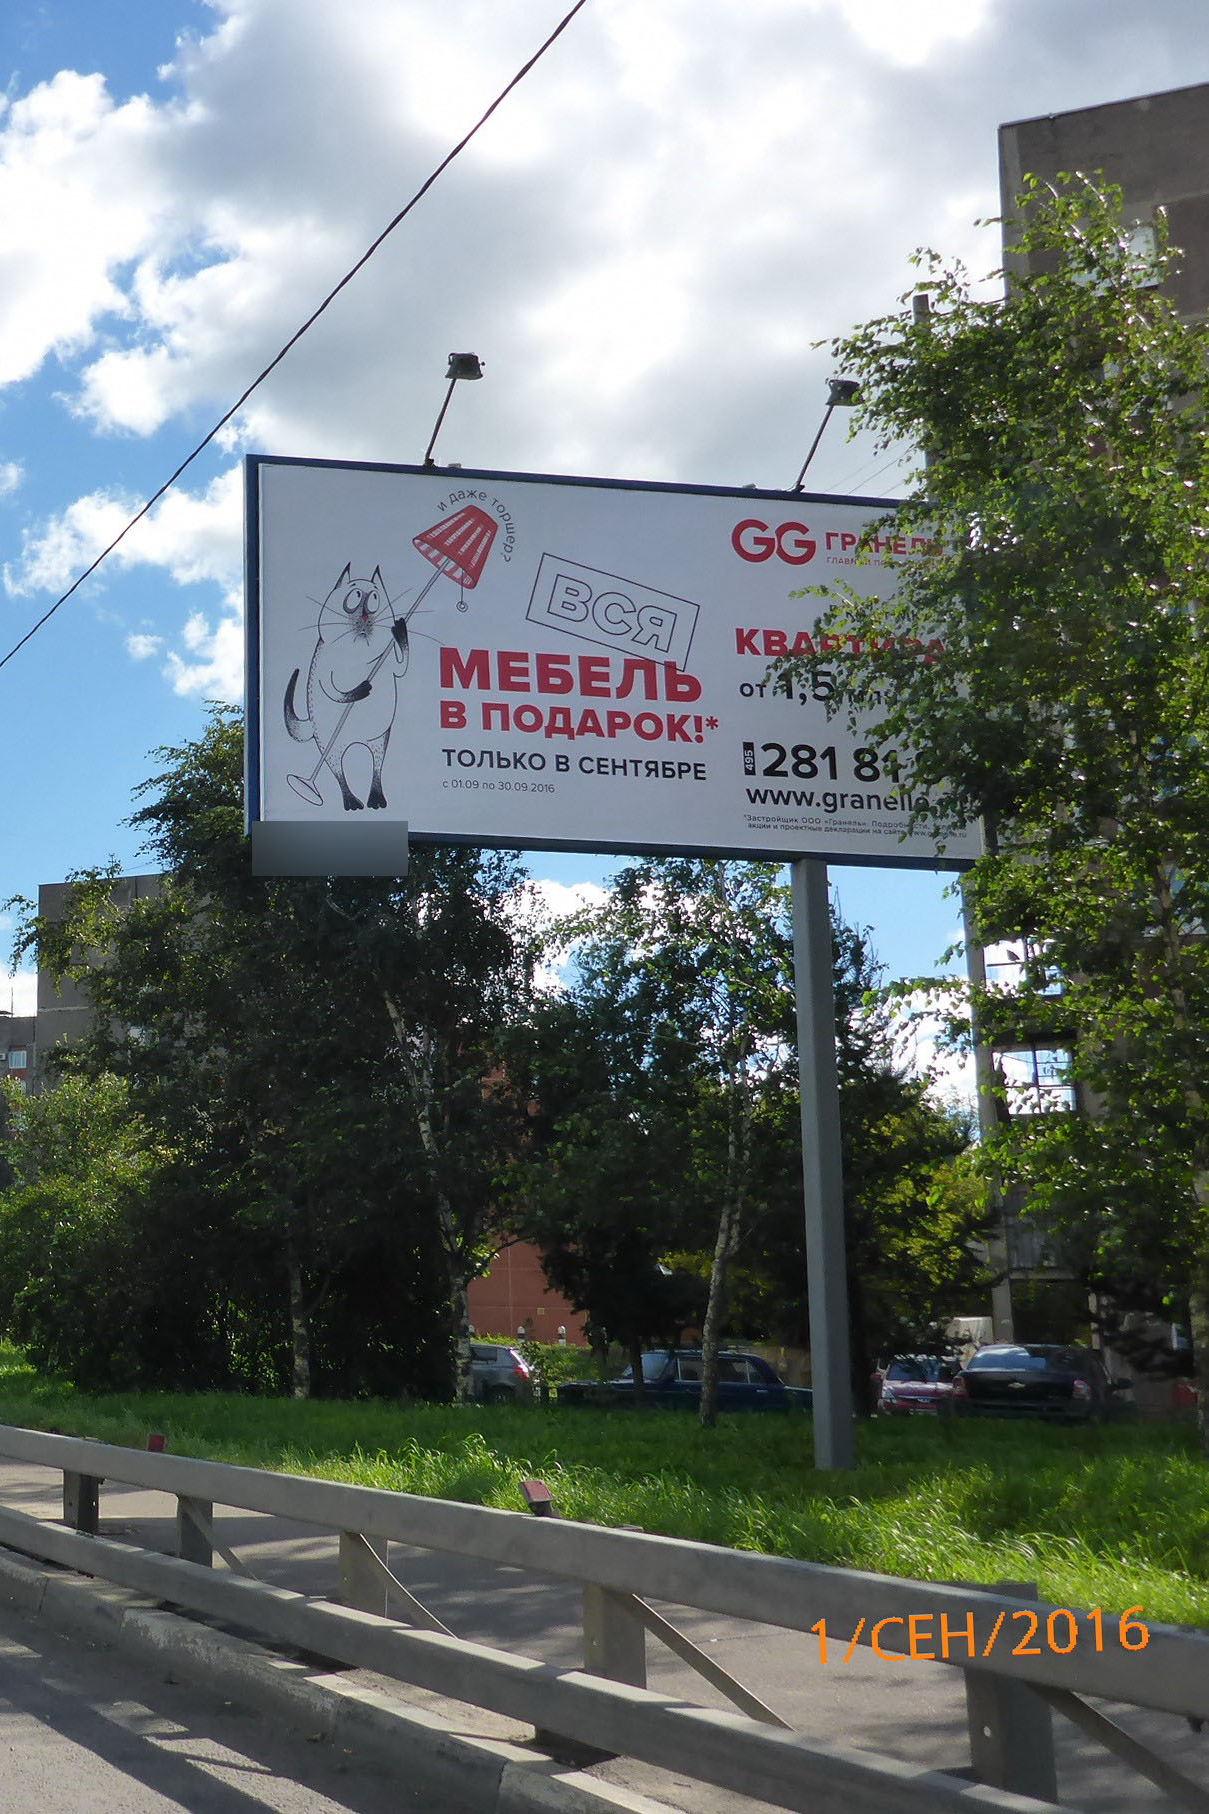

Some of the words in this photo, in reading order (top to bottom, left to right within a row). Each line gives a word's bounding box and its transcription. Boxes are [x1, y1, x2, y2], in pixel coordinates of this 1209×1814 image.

[437, 501, 448, 512] и
[448, 489, 488, 505] даже
[491, 497, 516, 563] торшер?
[731, 518, 817, 566] GG
[546, 573, 678, 653] ВСЯ
[440, 646, 702, 703] МЕБЕЛЬ
[739, 682, 767, 699] от
[440, 699, 468, 730] В
[441, 748, 547, 772] ТОЛЬКО
[554, 754, 571, 773] В
[577, 756, 708, 782] СЕНТЯБРЕ
[743, 749, 755, 771] 495
[761, 742, 839, 781] 281
[441, 780, 449, 788] с
[450, 779, 480, 790] 01.09
[482, 781, 496, 790] по
[801, 816, 822, 825] ООО
